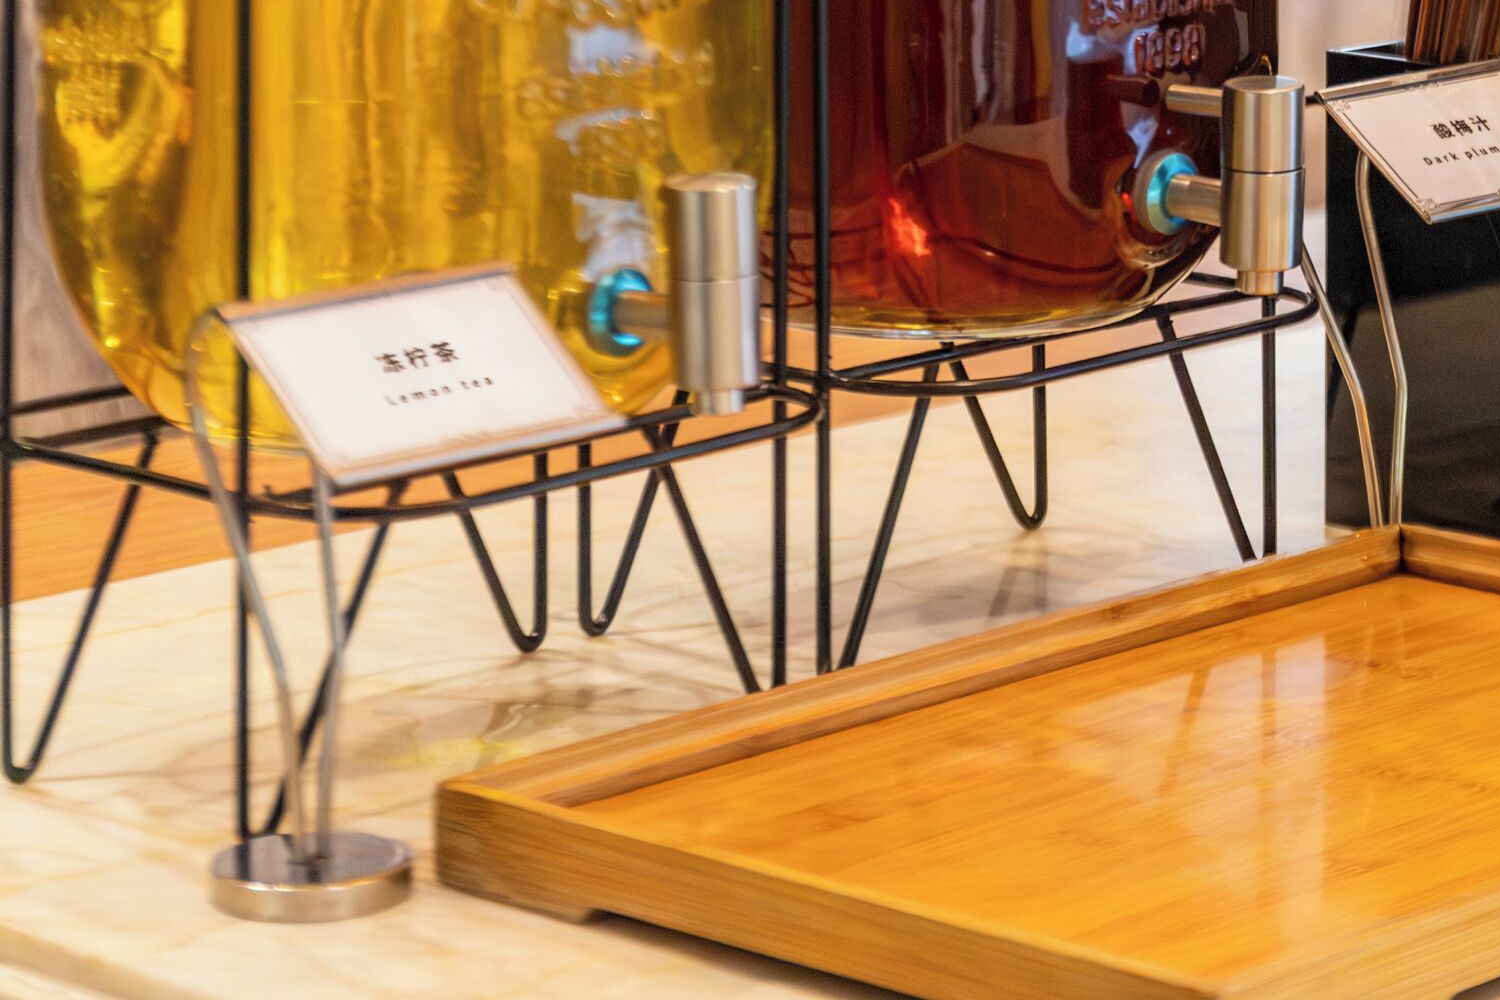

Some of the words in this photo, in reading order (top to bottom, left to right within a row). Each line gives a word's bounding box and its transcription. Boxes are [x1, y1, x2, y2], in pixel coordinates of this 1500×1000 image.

[1431, 115, 1491, 139] 酸梅汁
[1423, 152, 1460, 166] Dark
[1464, 145, 1500, 160] plum
[374, 341, 459, 373] 冻柠茶
[384, 385, 452, 406] Lemon
[459, 376, 493, 390] tea
